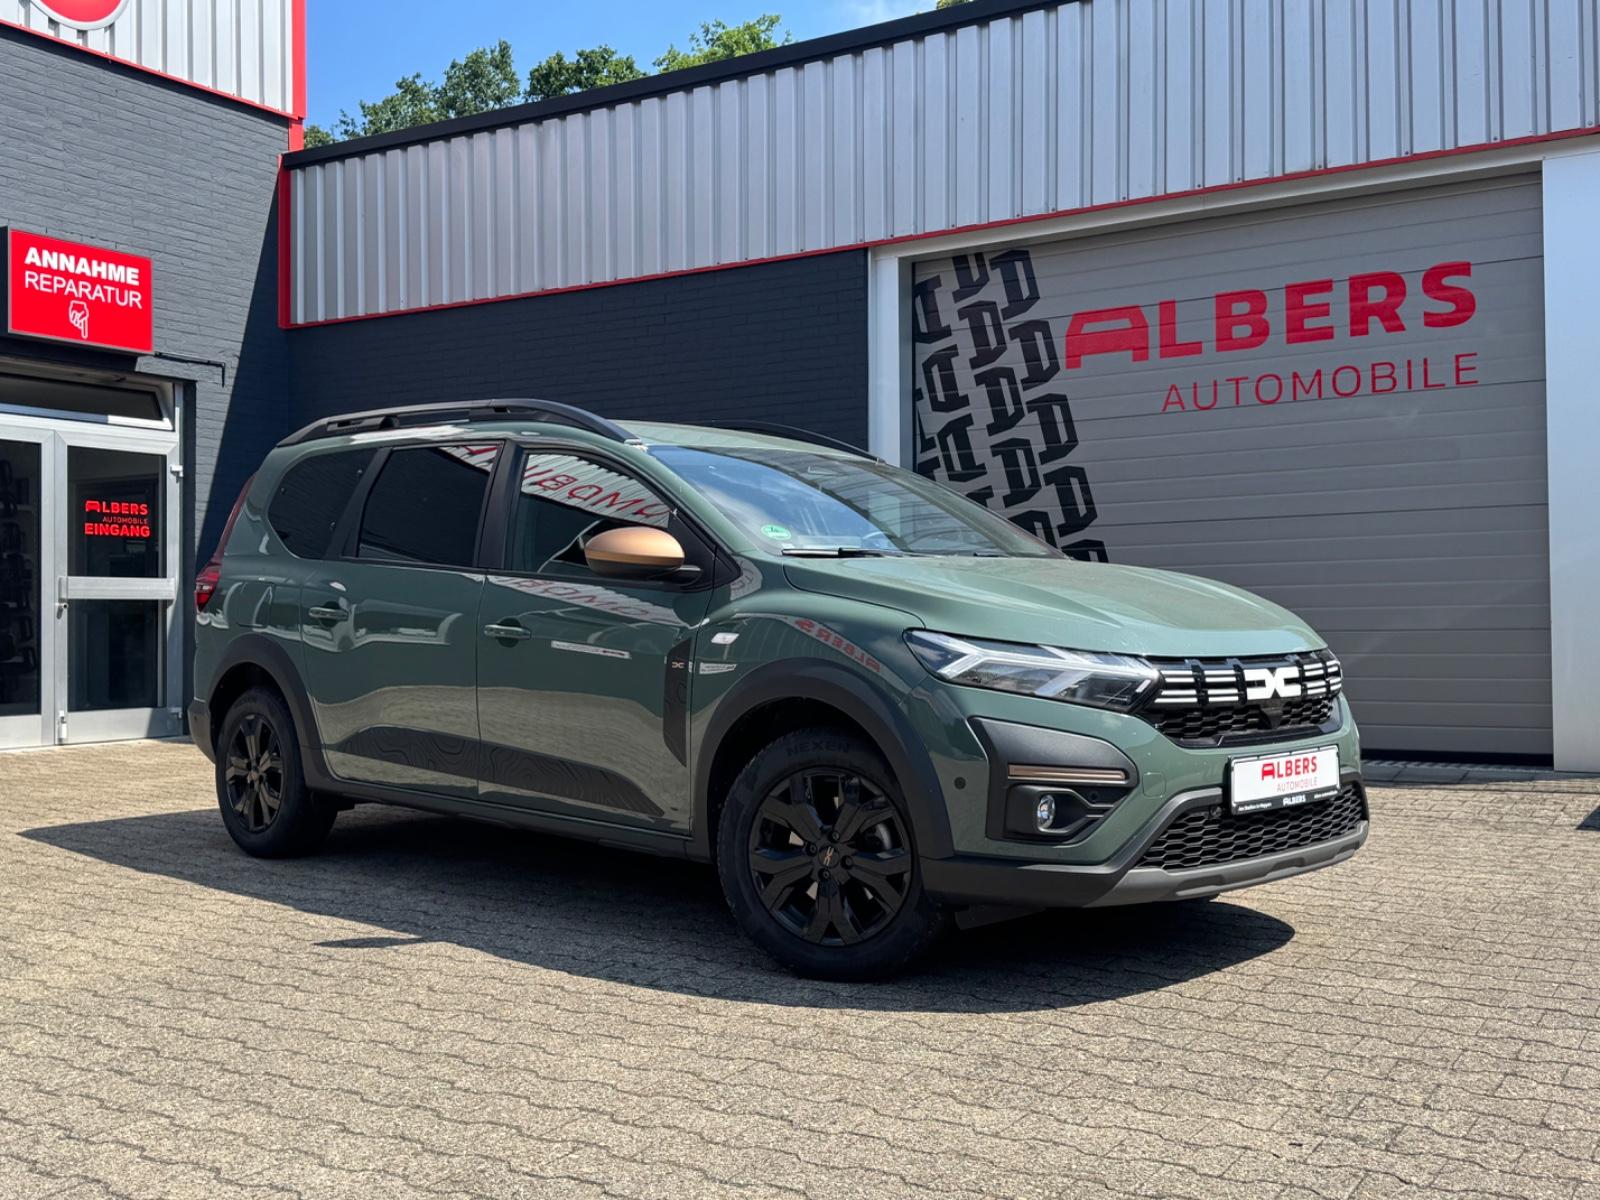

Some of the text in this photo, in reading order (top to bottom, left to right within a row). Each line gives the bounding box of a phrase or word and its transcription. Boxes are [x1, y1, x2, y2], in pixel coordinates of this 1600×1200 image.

[24, 246, 140, 286] ANNAHME
[25, 270, 143, 310] REPARATUR
[1064, 261, 1478, 370] ALBERS
[1161, 352, 1479, 413] AUTOMOBILE
[85, 500, 149, 516] ALBERS
[102, 516, 149, 525] AUTOMOBILE
[84, 522, 151, 537] EINGANG
[1261, 756, 1318, 781] ALBERS
[1277, 777, 1318, 793] AUTOMOBILE
